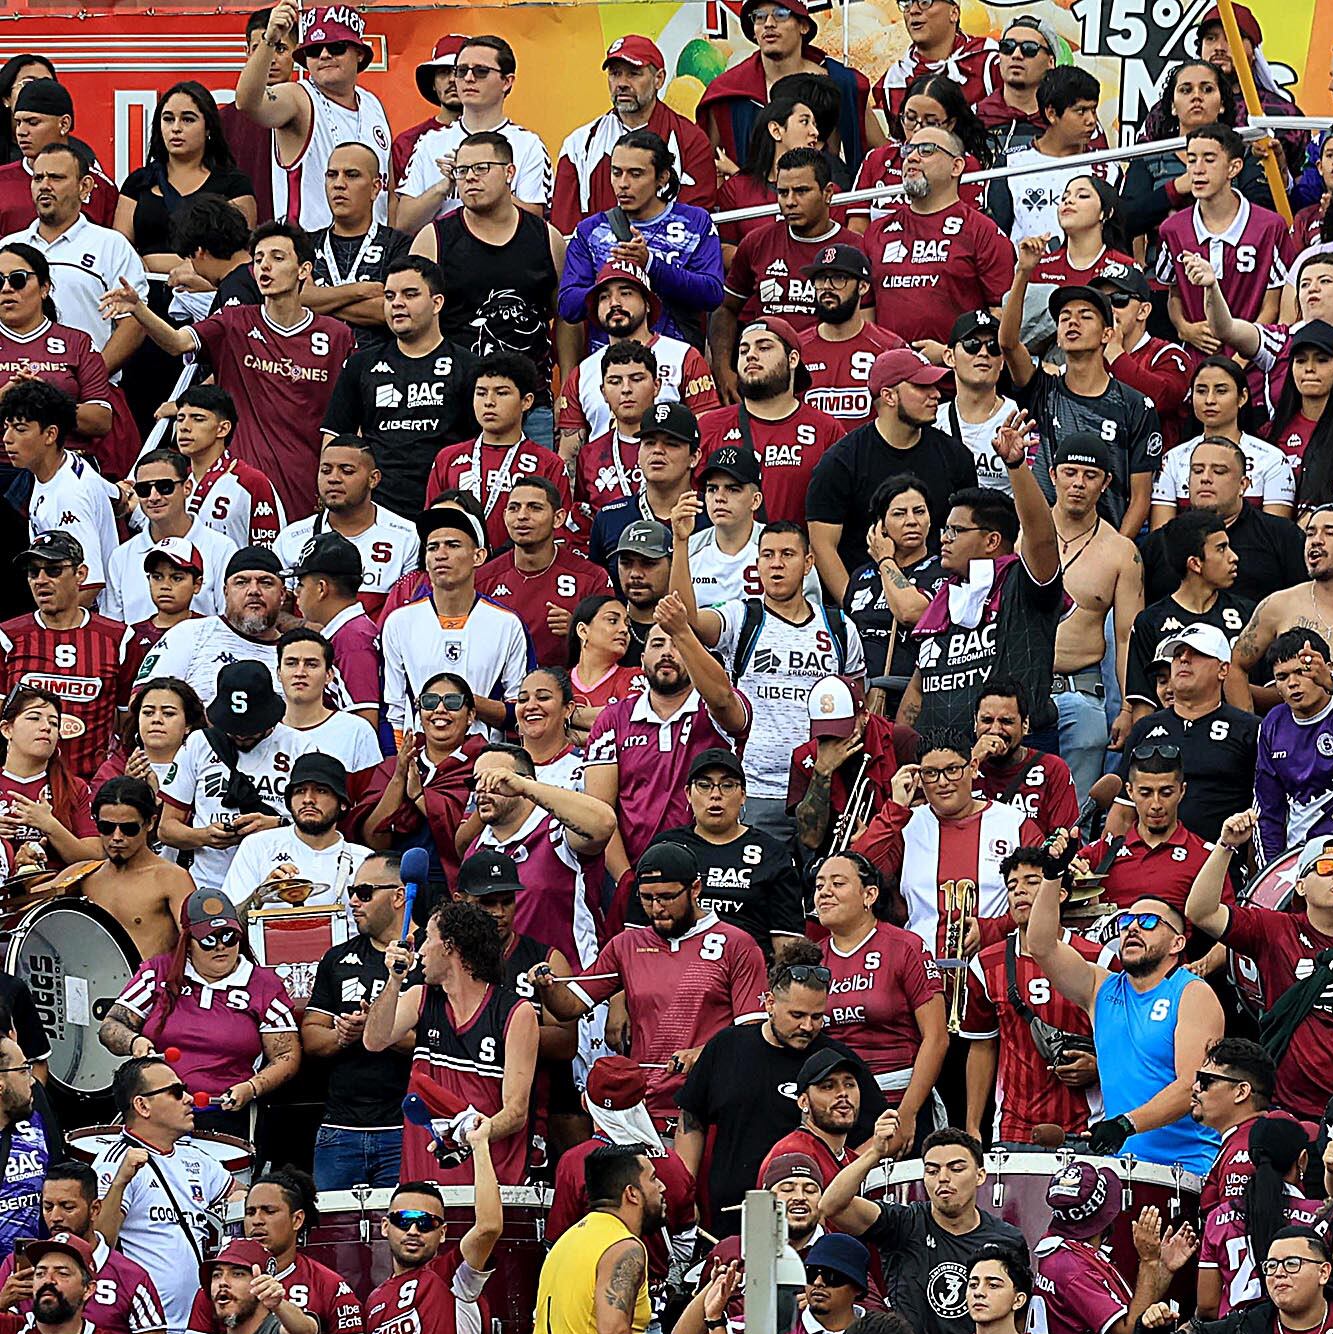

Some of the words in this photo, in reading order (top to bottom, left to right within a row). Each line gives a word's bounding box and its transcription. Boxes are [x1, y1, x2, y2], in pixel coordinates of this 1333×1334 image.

[911, 241, 950, 257] BAC
[881, 275, 940, 288] LIBERTY
[407, 383, 444, 401] BAC
[407, 400, 443, 408] CREDOMATIC
[378, 419, 439, 432] LIBERTY
[764, 446, 801, 461] BAC
[252, 528, 275, 541] Uber
[949, 632, 996, 655] BAC
[789, 651, 834, 670] BAC
[947, 648, 996, 664] CREDOMATIC
[923, 667, 992, 692] LIBERTY
[708, 868, 752, 881] BAC
[829, 974, 874, 993] kölbi
[832, 1007, 865, 1021] BAC
[6, 1156, 43, 1175] BAC
[339, 1317, 362, 1329] Eats
